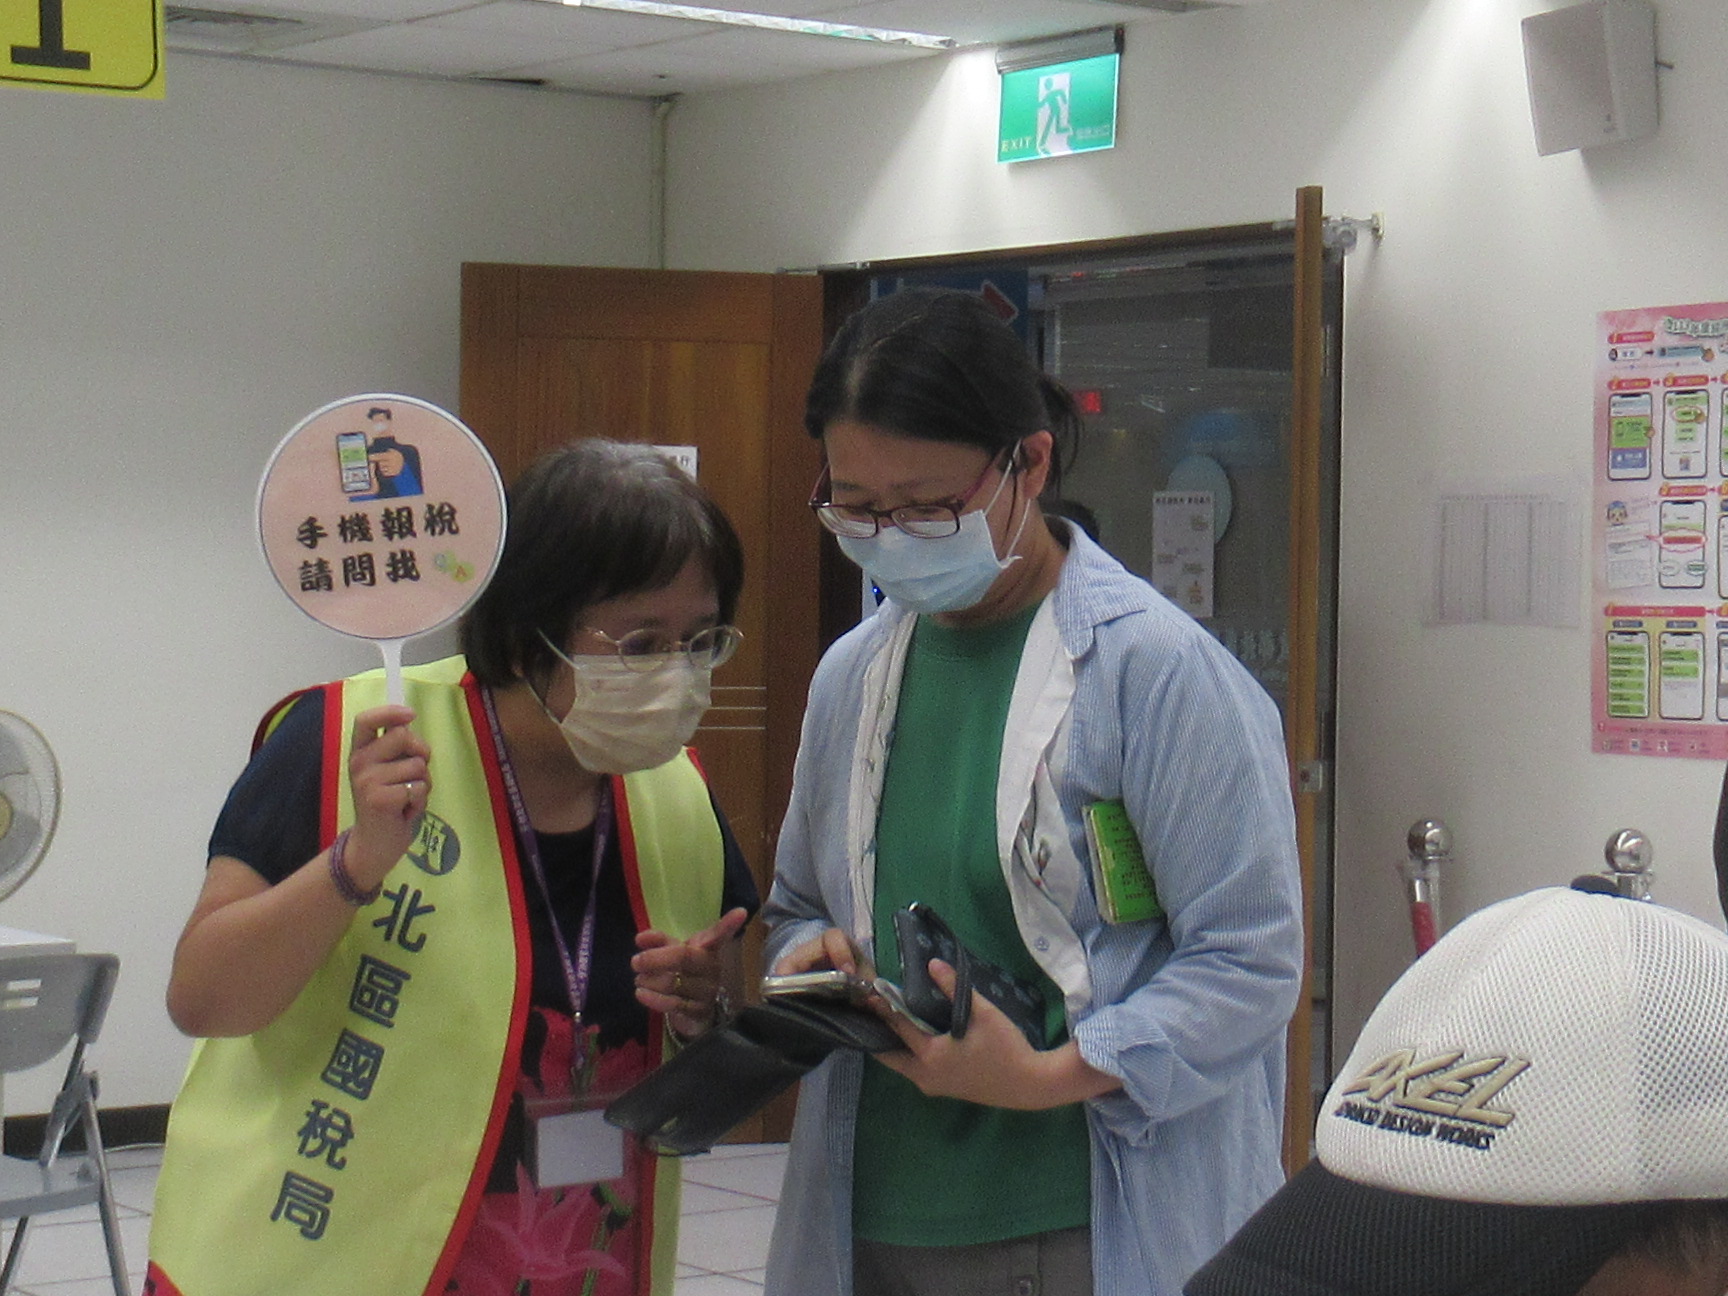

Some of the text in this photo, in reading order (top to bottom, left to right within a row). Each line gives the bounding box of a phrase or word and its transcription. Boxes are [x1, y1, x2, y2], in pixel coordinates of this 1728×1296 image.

[1001, 136, 1032, 153] EXIT
[297, 501, 459, 550] 手機報稅
[269, 881, 436, 1241] 北區國稅局
